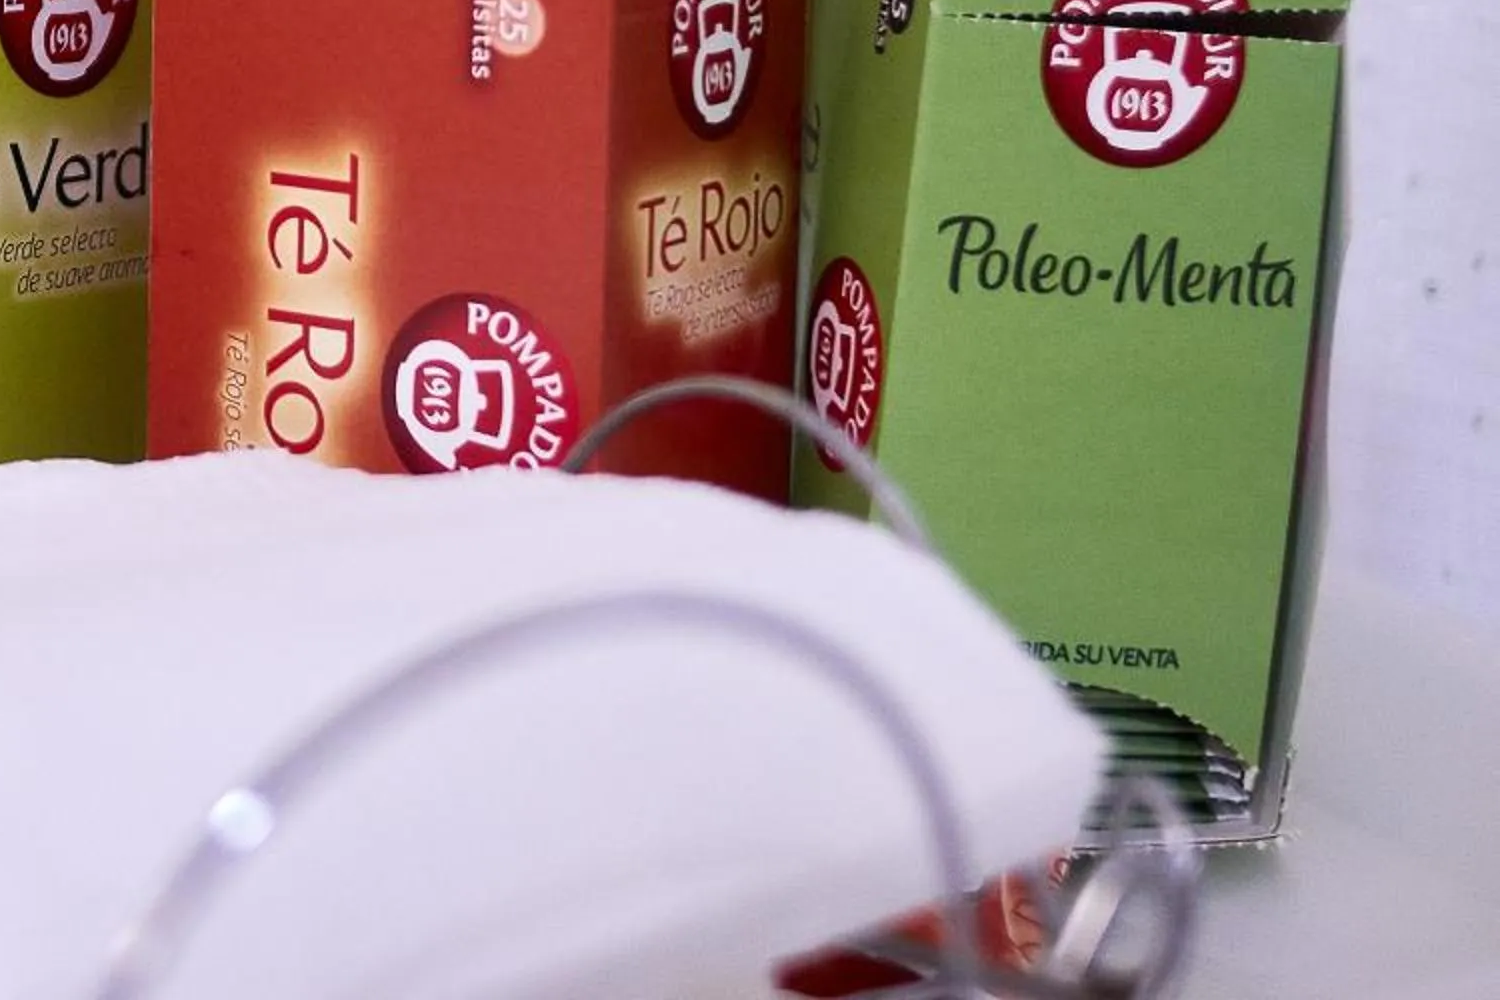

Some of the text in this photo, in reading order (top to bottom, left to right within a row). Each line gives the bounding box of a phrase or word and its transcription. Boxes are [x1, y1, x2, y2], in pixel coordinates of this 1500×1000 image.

[50, 22, 88, 54] 1913
[705, 61, 734, 95] 1913
[1111, 87, 1167, 121] 1913
[9, 121, 149, 213] Verd
[50, 226, 117, 257] selecto
[638, 173, 783, 278] Té Rojo
[17, 266, 41, 295] de
[45, 266, 95, 292] suave
[938, 215, 1296, 308] Poleo-Menta
[264, 152, 359, 455] Té Ro
[226, 333, 249, 363] Té
[841, 268, 878, 445] POMPADO
[220, 367, 248, 421] Rojo
[421, 366, 452, 425] 1913
[467, 302, 567, 473] POMPADO
[1073, 643, 1103, 665] SU
[1107, 647, 1180, 669] VENTA
